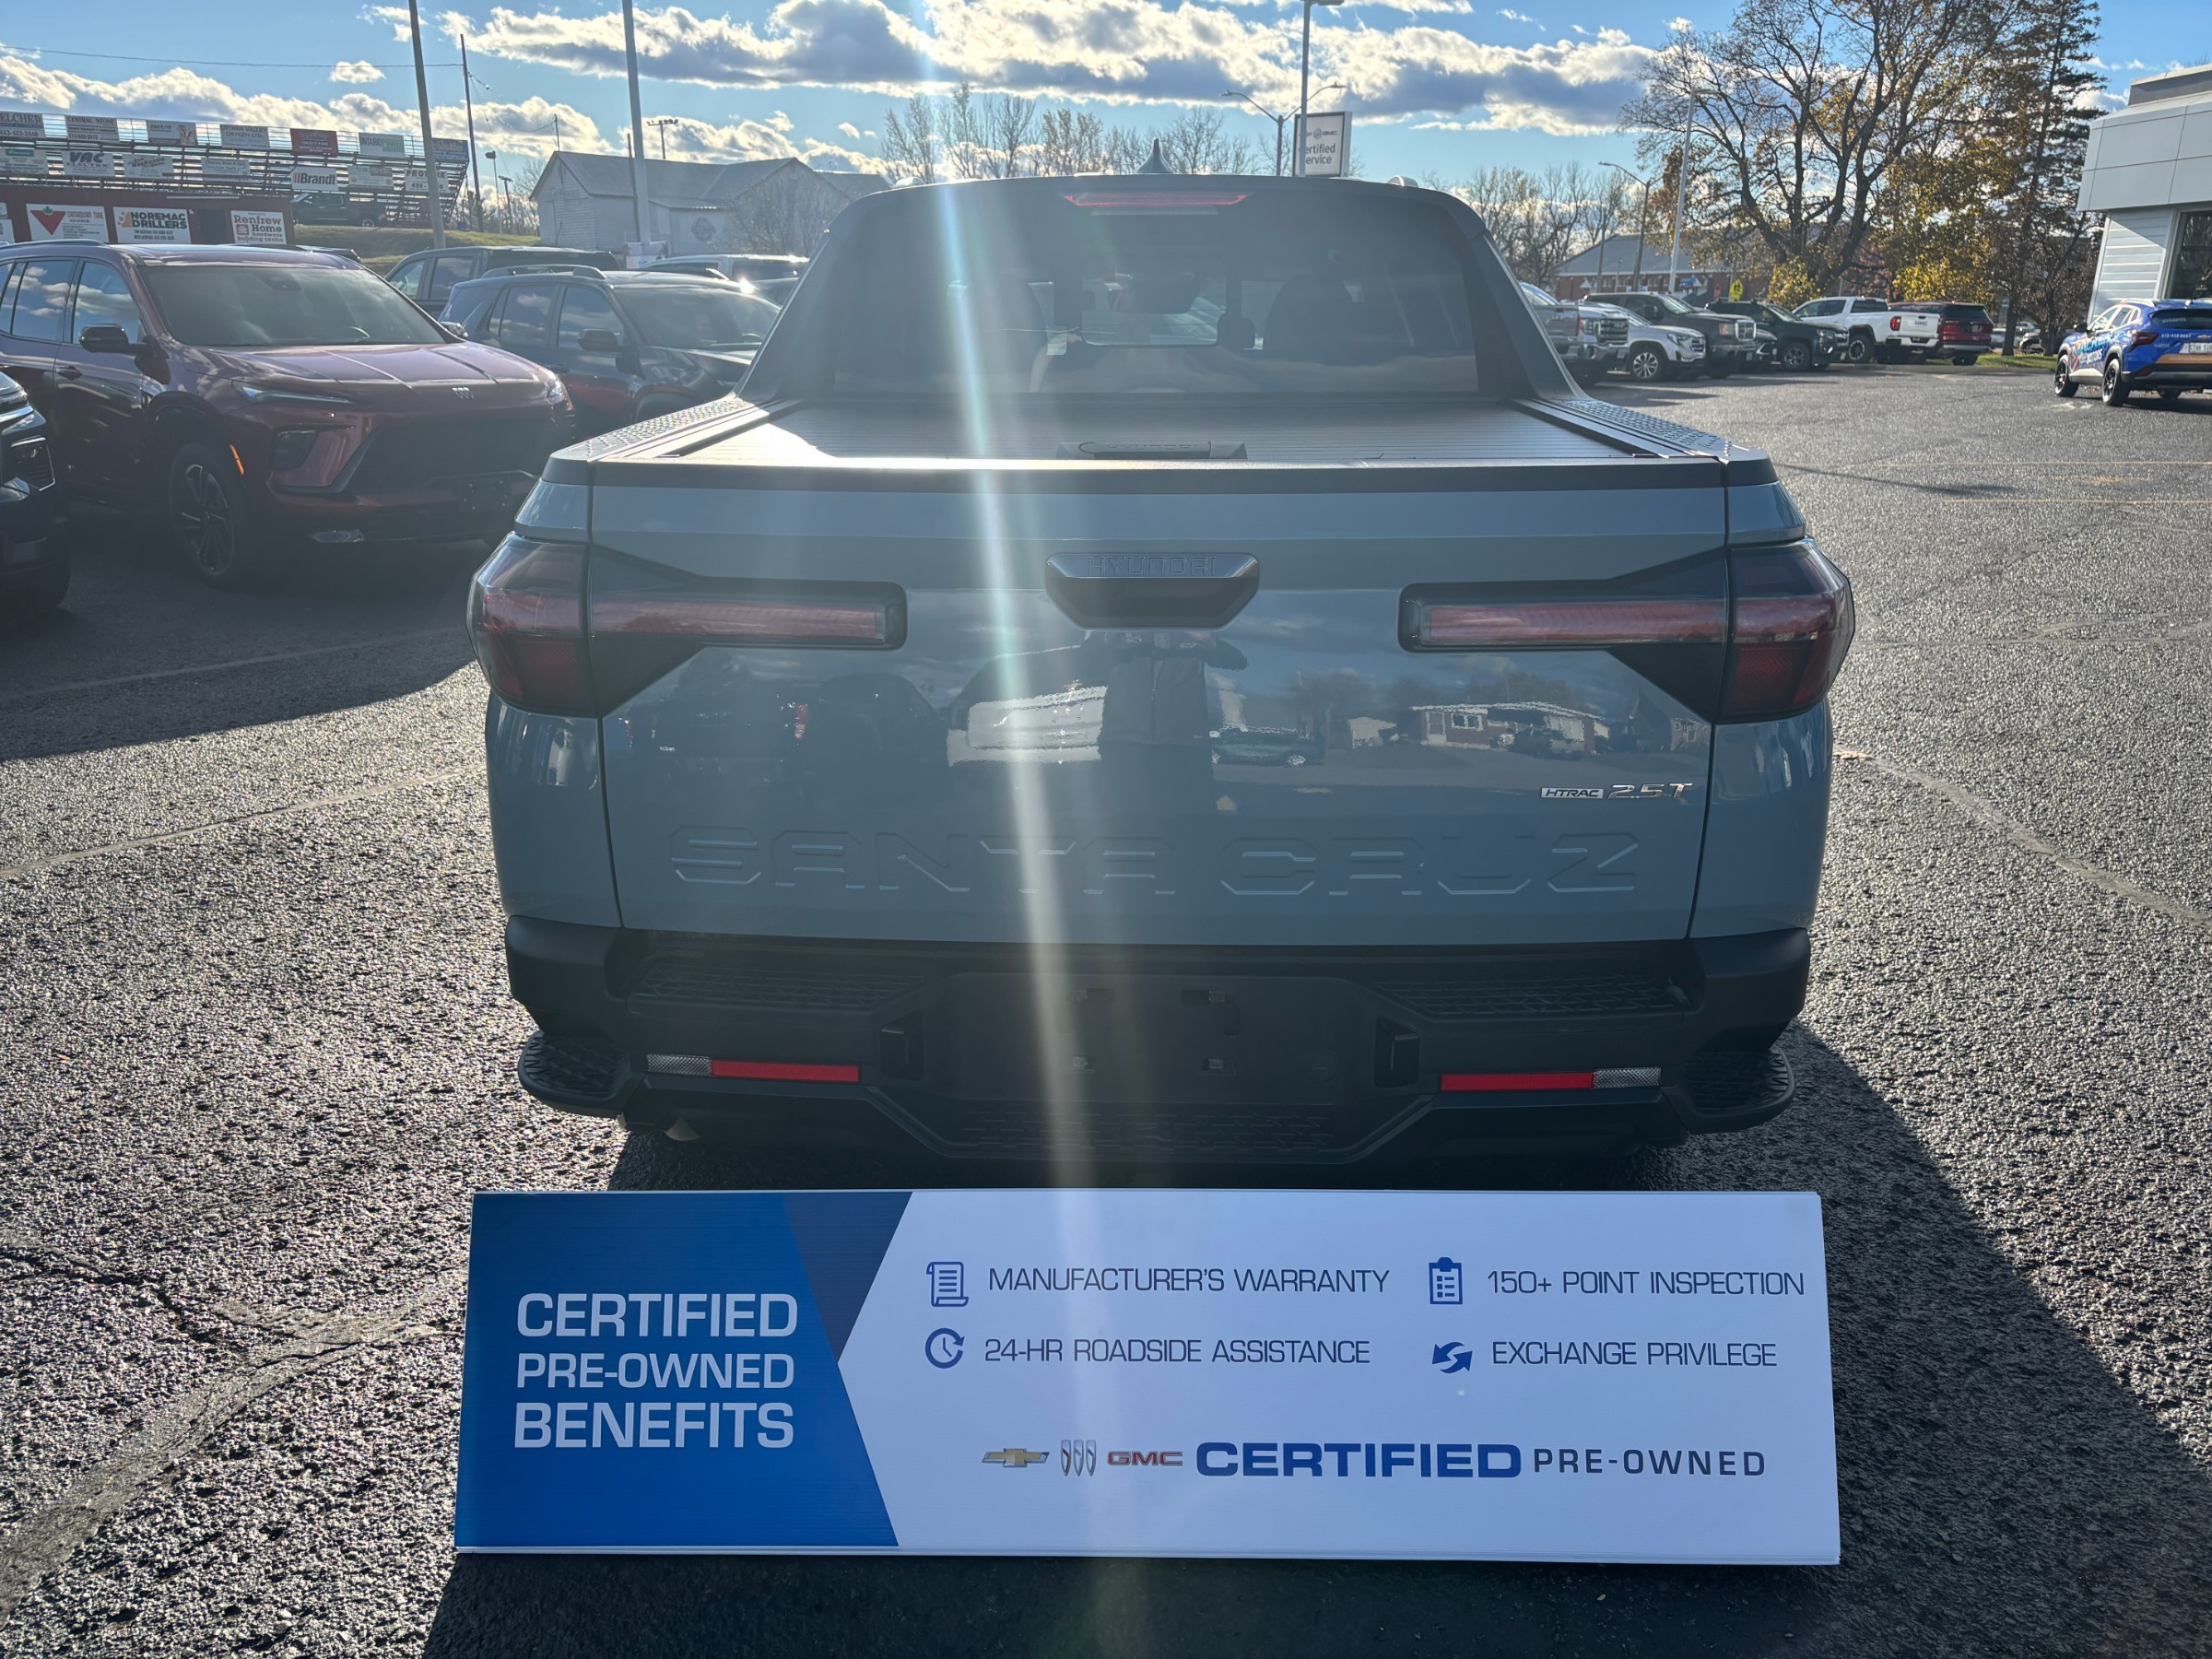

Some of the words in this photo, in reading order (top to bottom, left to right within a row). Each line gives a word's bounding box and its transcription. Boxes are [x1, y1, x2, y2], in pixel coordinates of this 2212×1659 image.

[70, 152, 104, 163] VAC
[1299, 143, 1335, 153] ertified
[1305, 155, 1332, 164] ervice
[300, 172, 335, 184] Brandt
[131, 212, 186, 221] NOREMAC
[132, 220, 187, 229] DRILLERS
[233, 215, 282, 224] Renfrew
[252, 224, 282, 233] Home
[1088, 556, 1218, 576] HYUNDAI
[1546, 789, 1600, 798] HTRAC
[1608, 782, 1694, 799] 2.5T
[670, 825, 1176, 895] SANTA
[1221, 832, 1639, 896] CRUZ
[989, 1267, 1226, 1292] MANUFACTURER'S
[1234, 1269, 1391, 1293] WARRANTY
[1488, 1270, 1552, 1294] 150+
[1563, 1271, 1640, 1294] POINT
[1651, 1272, 1805, 1296] INSPECTION
[517, 1292, 798, 1337] CERTIFIED
[984, 1339, 1063, 1362] 24-HR
[1073, 1339, 1202, 1363] ROADSIDE
[1211, 1339, 1371, 1364] ASSISTANCE
[1492, 1342, 1637, 1365] EXCHANGE
[1647, 1343, 1778, 1367] PRIVILEGE
[517, 1353, 794, 1388] PRE-OWNED
[514, 1402, 794, 1448] BENEFITS
[1107, 1451, 1183, 1466] GMC
[1196, 1441, 1522, 1478] CERTIFIED
[1534, 1448, 1765, 1476] PRE-OWNED
